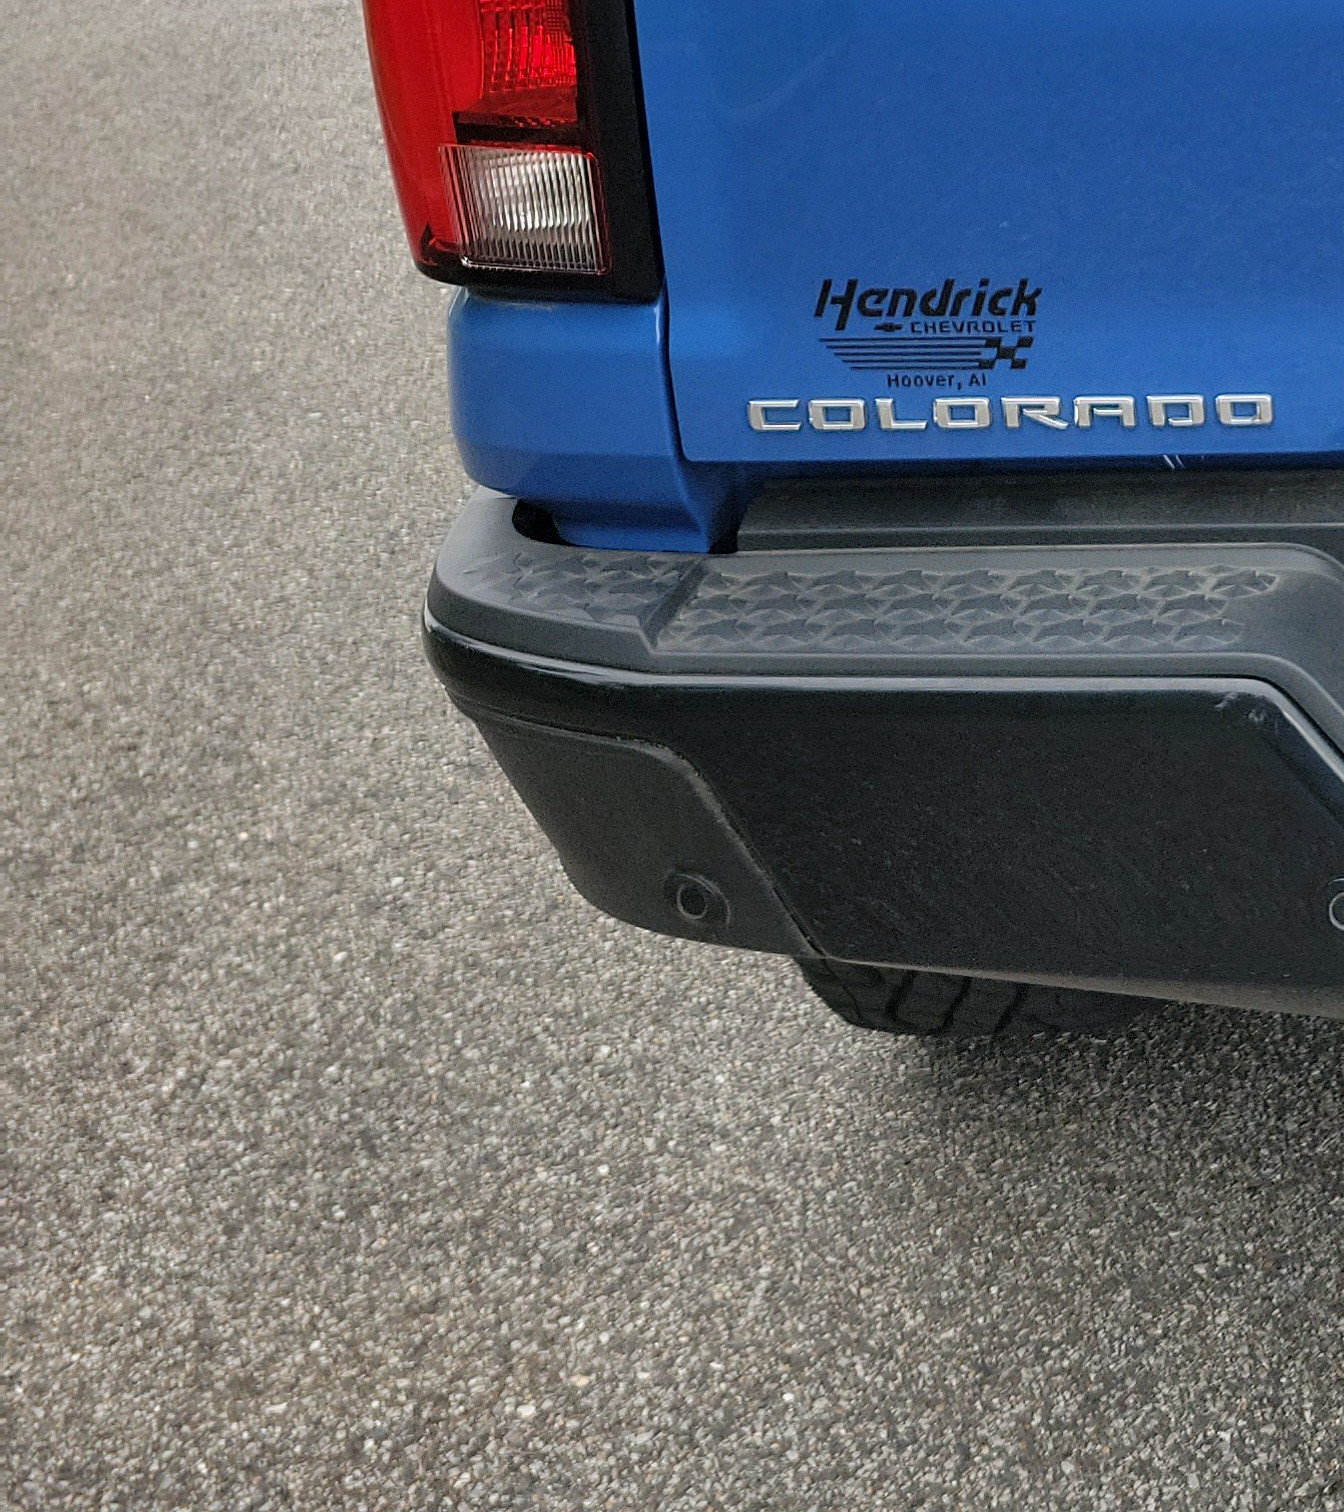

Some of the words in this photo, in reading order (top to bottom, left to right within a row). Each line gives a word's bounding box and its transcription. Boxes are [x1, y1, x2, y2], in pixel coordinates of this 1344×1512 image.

[813, 278, 1042, 331] Hendrick
[910, 319, 1037, 334] CHEVROLET
[886, 373, 962, 390] Hoover,
[747, 394, 1274, 431] COLORADO
